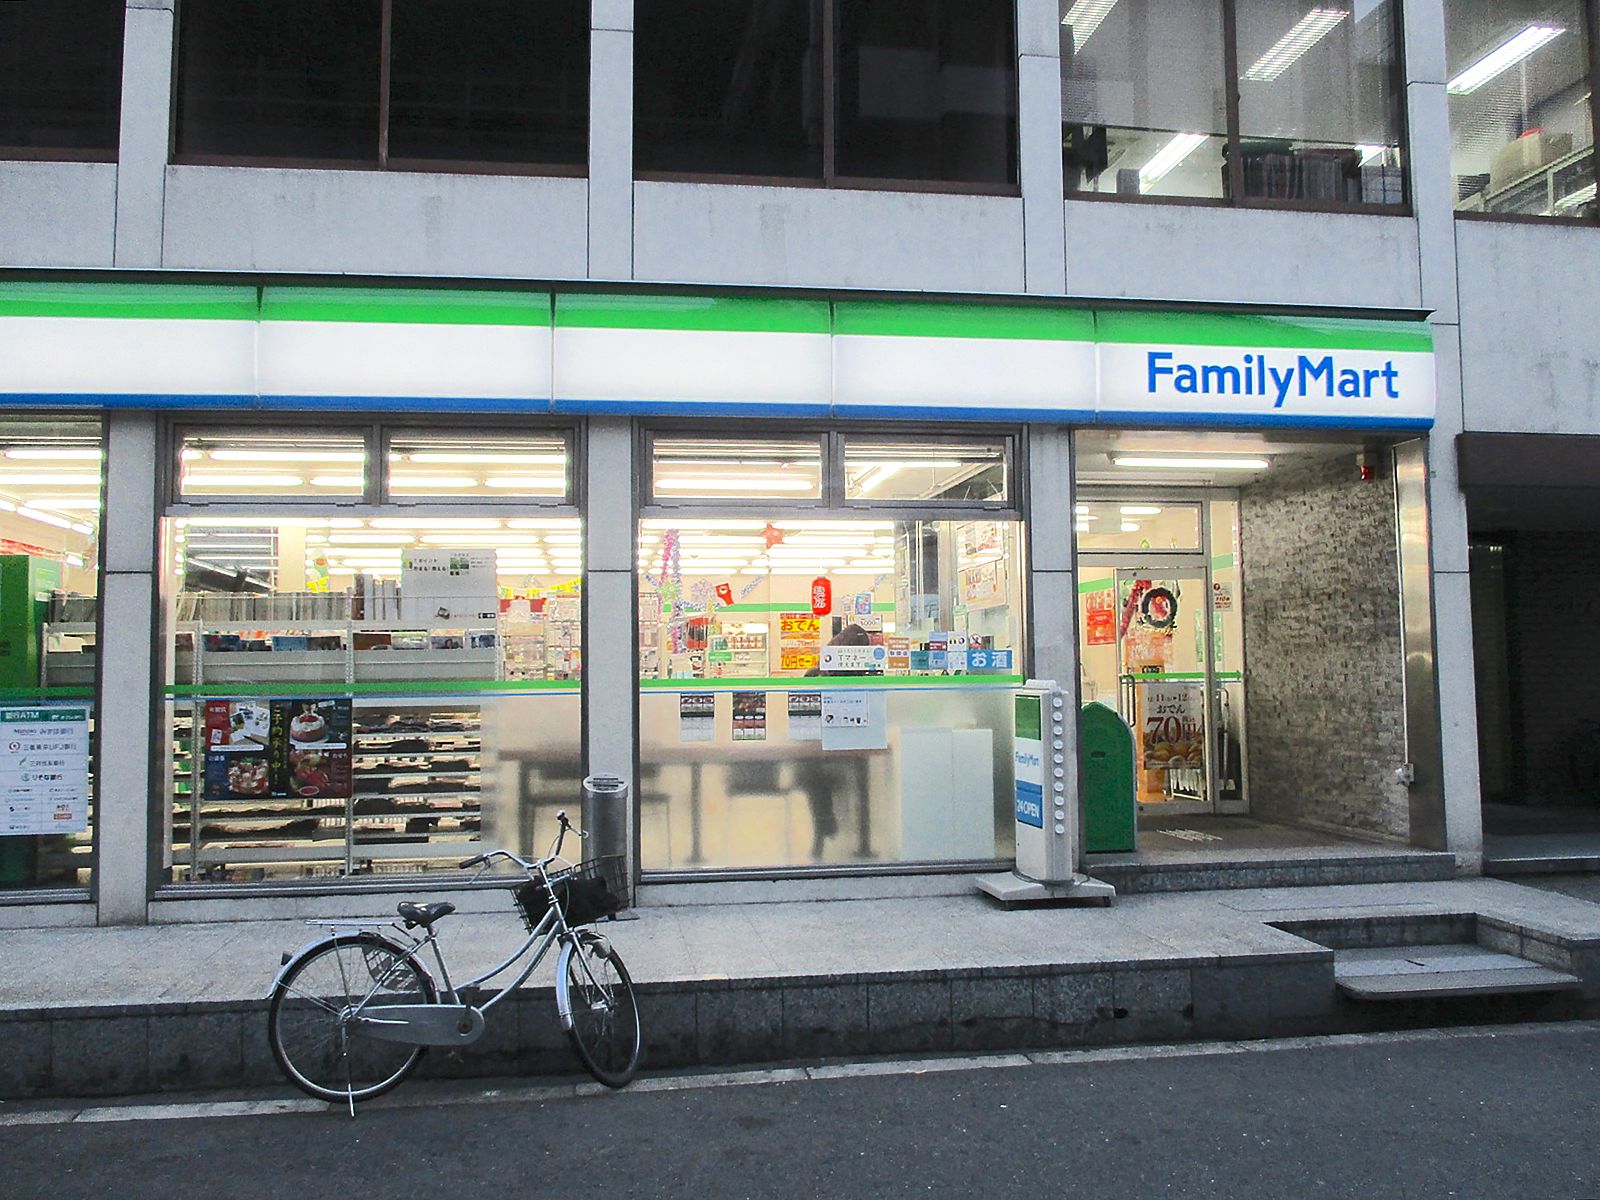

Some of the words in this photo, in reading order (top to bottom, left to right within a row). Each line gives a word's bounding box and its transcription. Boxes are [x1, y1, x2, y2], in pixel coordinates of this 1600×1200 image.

[1147, 351, 1399, 408] FamilyMart
[781, 619, 820, 631] おでん
[971, 651, 1008, 668] お酒
